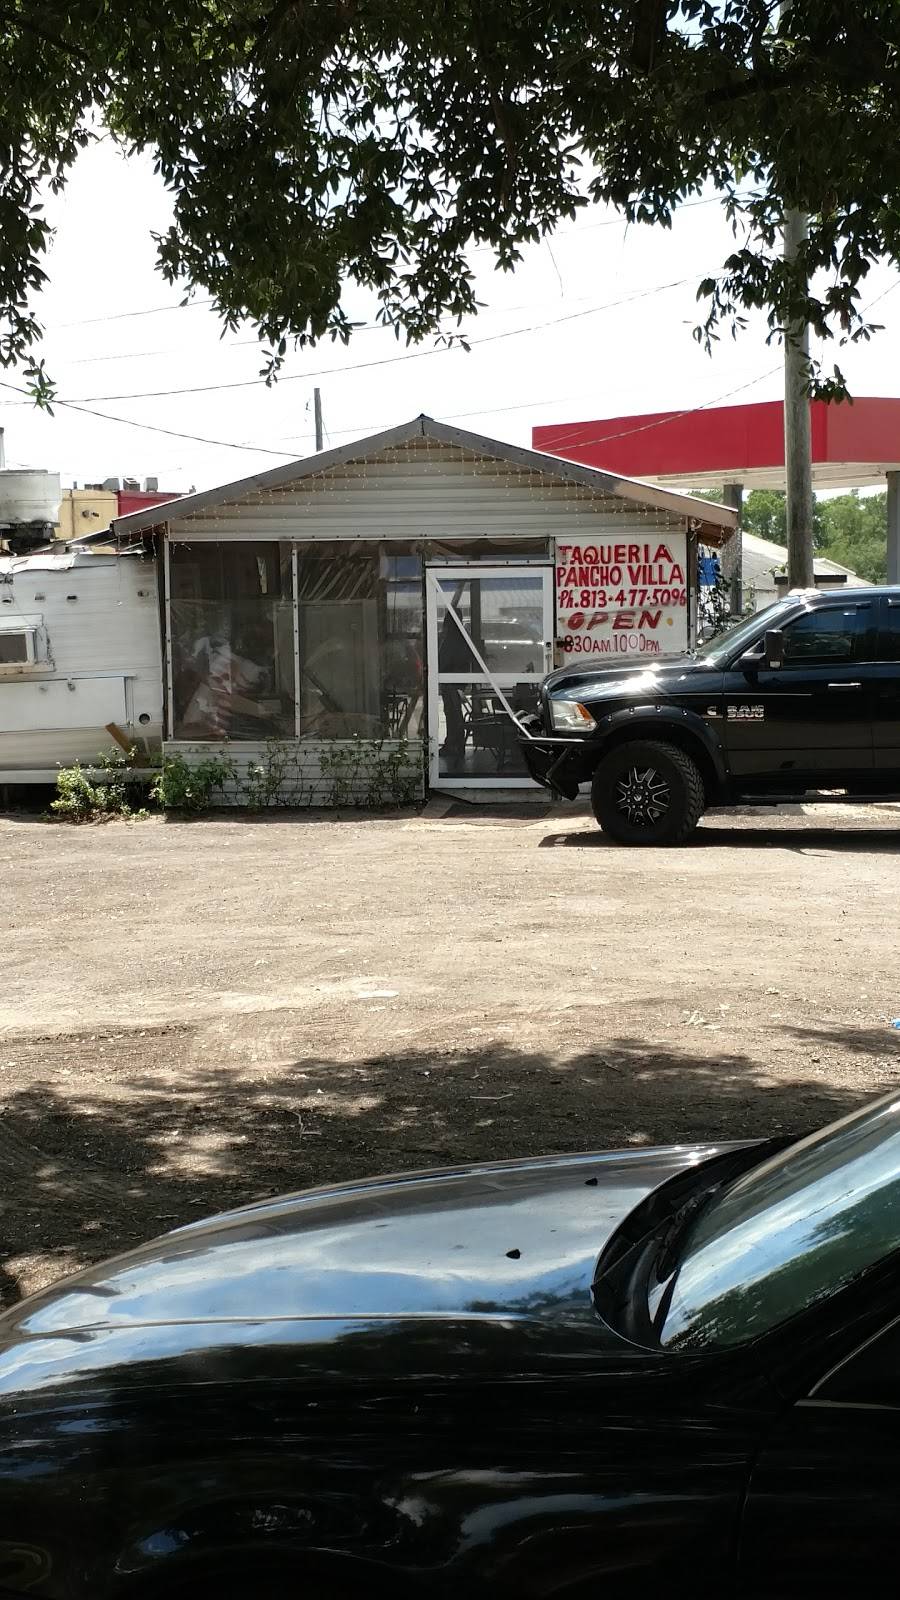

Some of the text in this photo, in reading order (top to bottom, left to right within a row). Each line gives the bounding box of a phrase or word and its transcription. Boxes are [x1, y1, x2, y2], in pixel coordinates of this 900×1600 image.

[558, 544, 674, 565] TAQUERIA
[556, 564, 684, 587] PANCHO VILLA
[567, 609, 662, 630] OPEN
